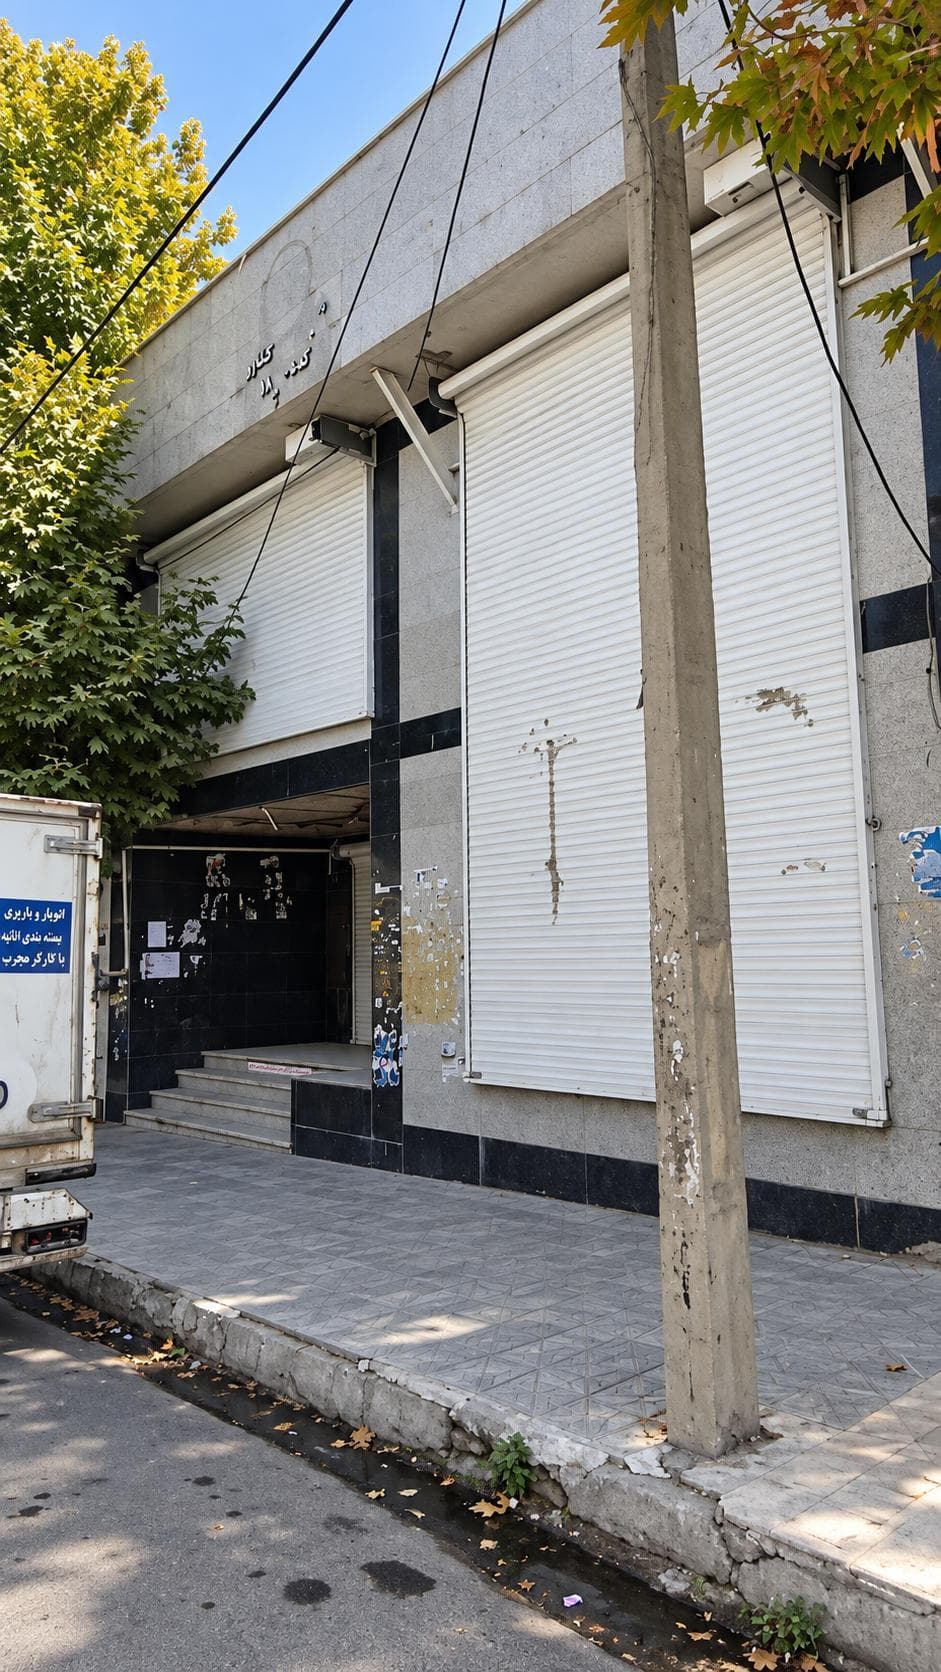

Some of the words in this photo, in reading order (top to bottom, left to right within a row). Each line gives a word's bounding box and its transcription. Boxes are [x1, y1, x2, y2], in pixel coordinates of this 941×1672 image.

[4, 906, 33, 921] باربری
[34, 911, 40, 921] و
[22, 931, 42, 945] بندی
[43, 932, 62, 946] بسته
[1, 954, 30, 967] مجرب
[58, 952, 65, 967] با
